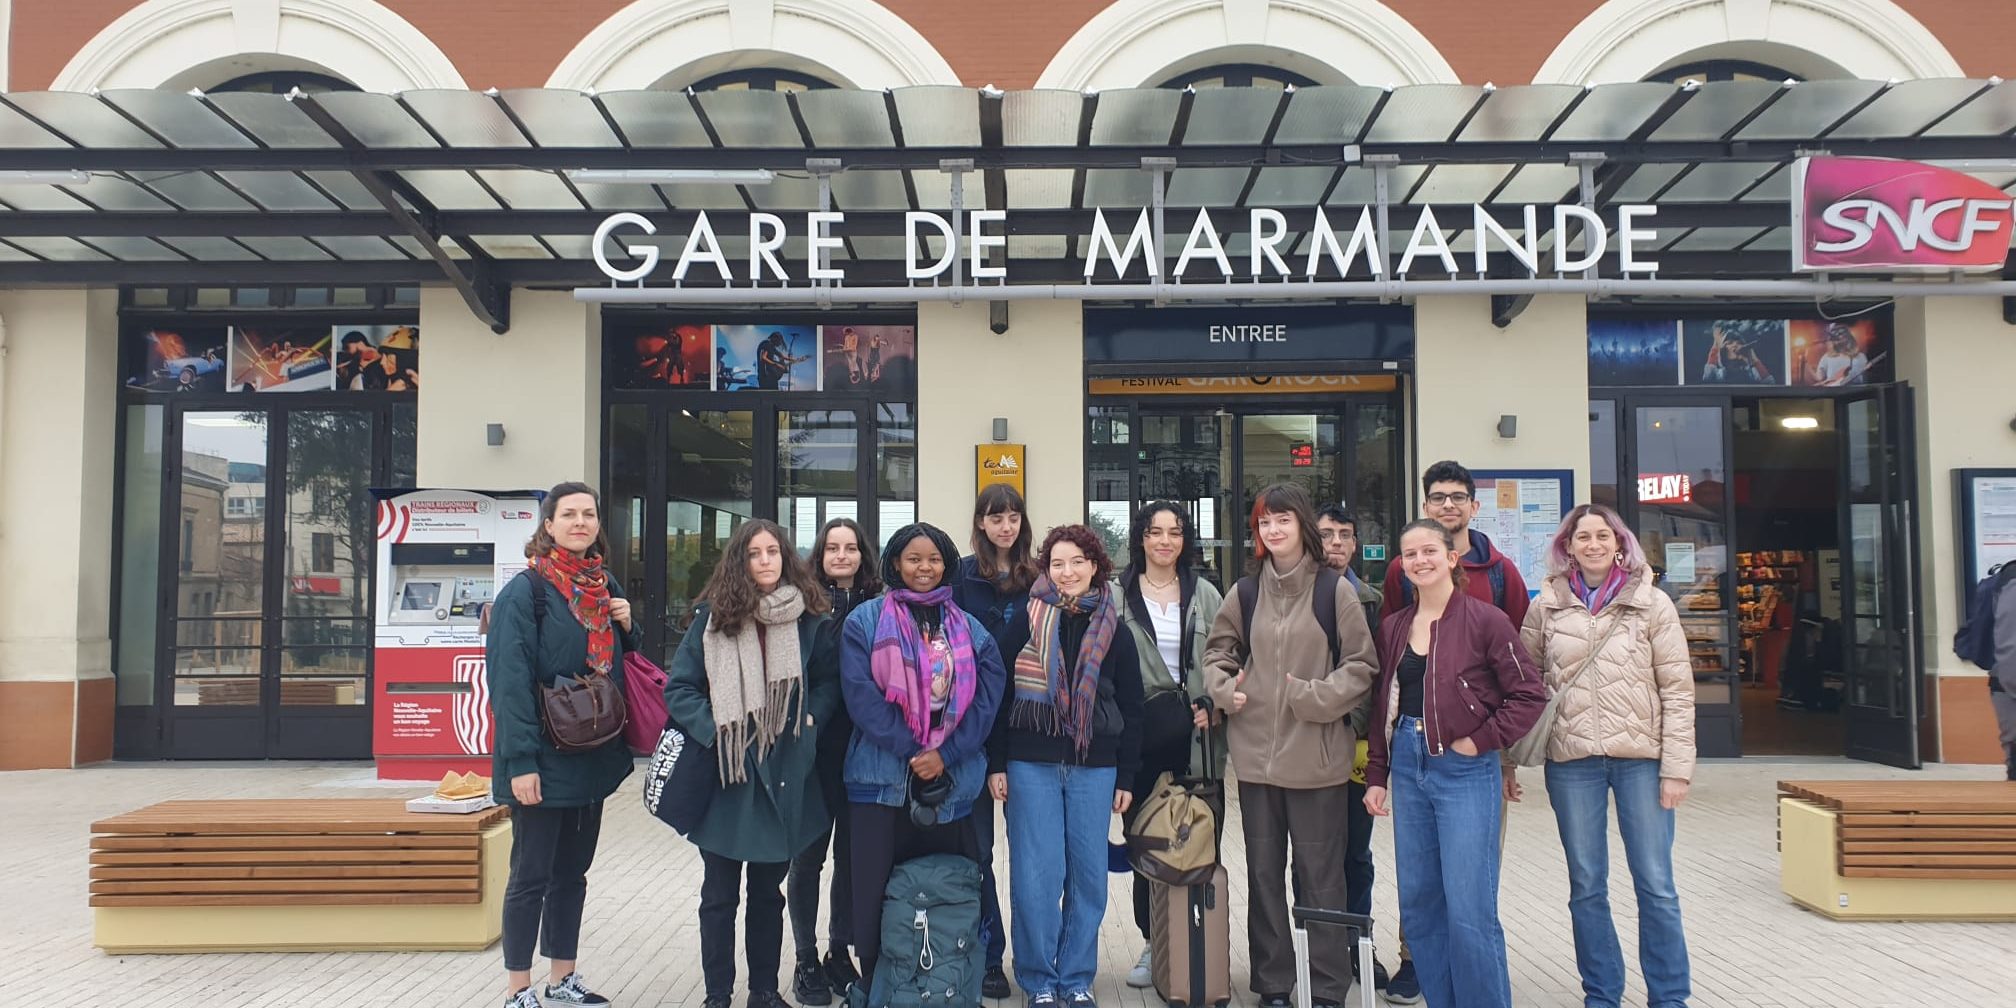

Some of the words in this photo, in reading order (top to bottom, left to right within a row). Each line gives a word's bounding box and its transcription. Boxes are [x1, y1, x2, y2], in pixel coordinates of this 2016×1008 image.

[592, 210, 845, 280] GARE
[905, 210, 1007, 278] DE
[1083, 202, 1659, 279] MARMANDE
[1814, 199, 2012, 251] SNCF
[1209, 325, 1287, 343] ENTREE
[1638, 475, 1681, 501] RELAY
